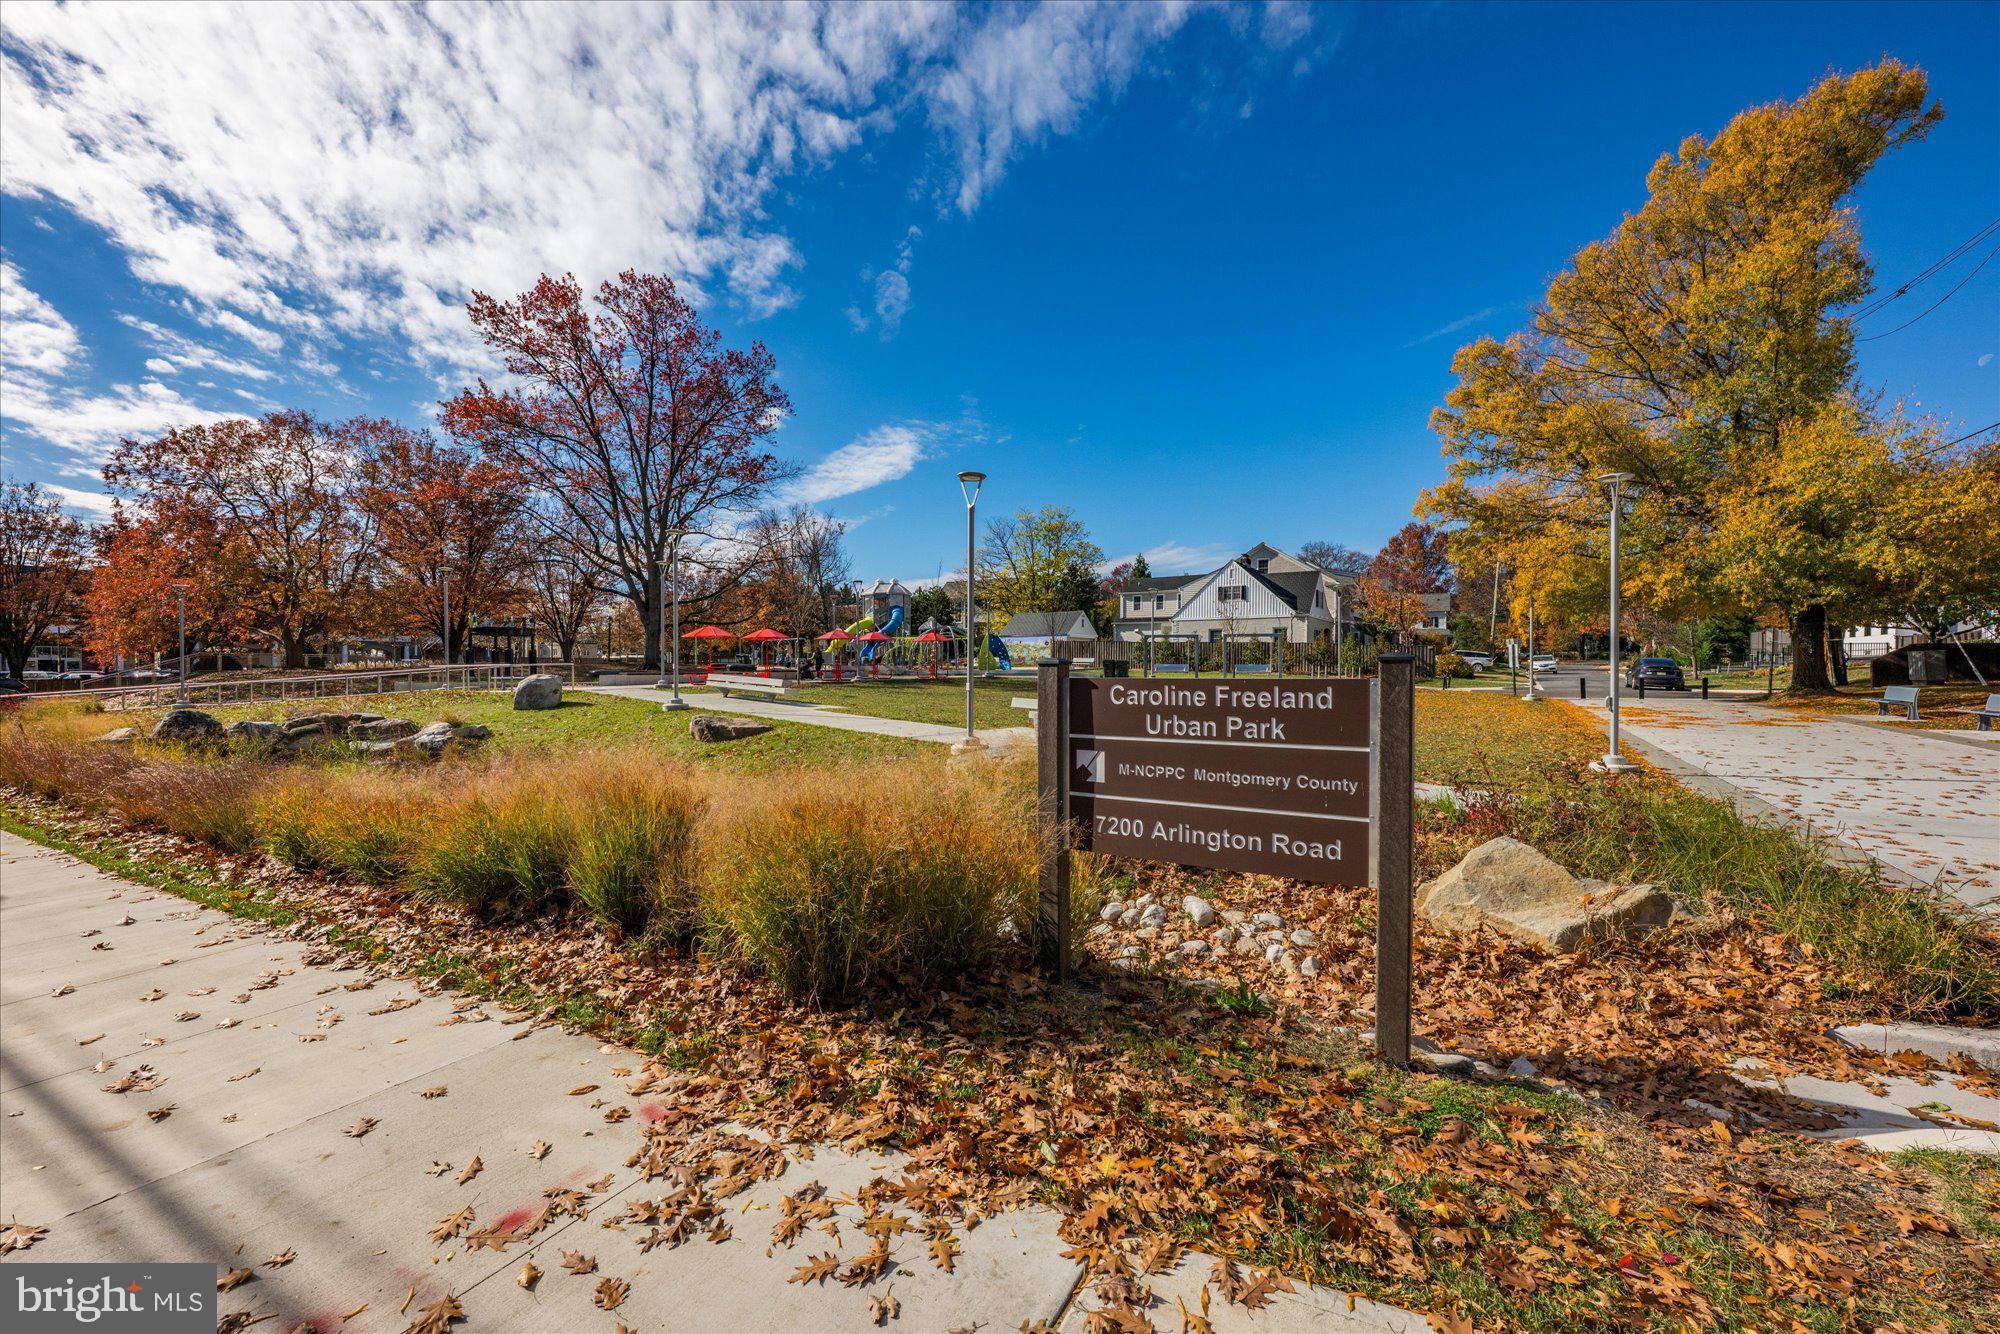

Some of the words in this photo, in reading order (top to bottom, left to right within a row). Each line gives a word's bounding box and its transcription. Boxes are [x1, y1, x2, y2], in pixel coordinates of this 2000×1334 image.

[1109, 685, 1206, 706] Caroline
[1214, 685, 1333, 710] Freeland
[1145, 714, 1217, 736] Urban
[1226, 716, 1286, 740] Park
[1118, 763, 1186, 780] M-NCPPC
[1193, 768, 1291, 790] Montgomery
[1296, 775, 1359, 795] County
[1096, 816, 1144, 838] 7200
[1151, 821, 1262, 852] Arlington
[1271, 833, 1342, 861] Road
